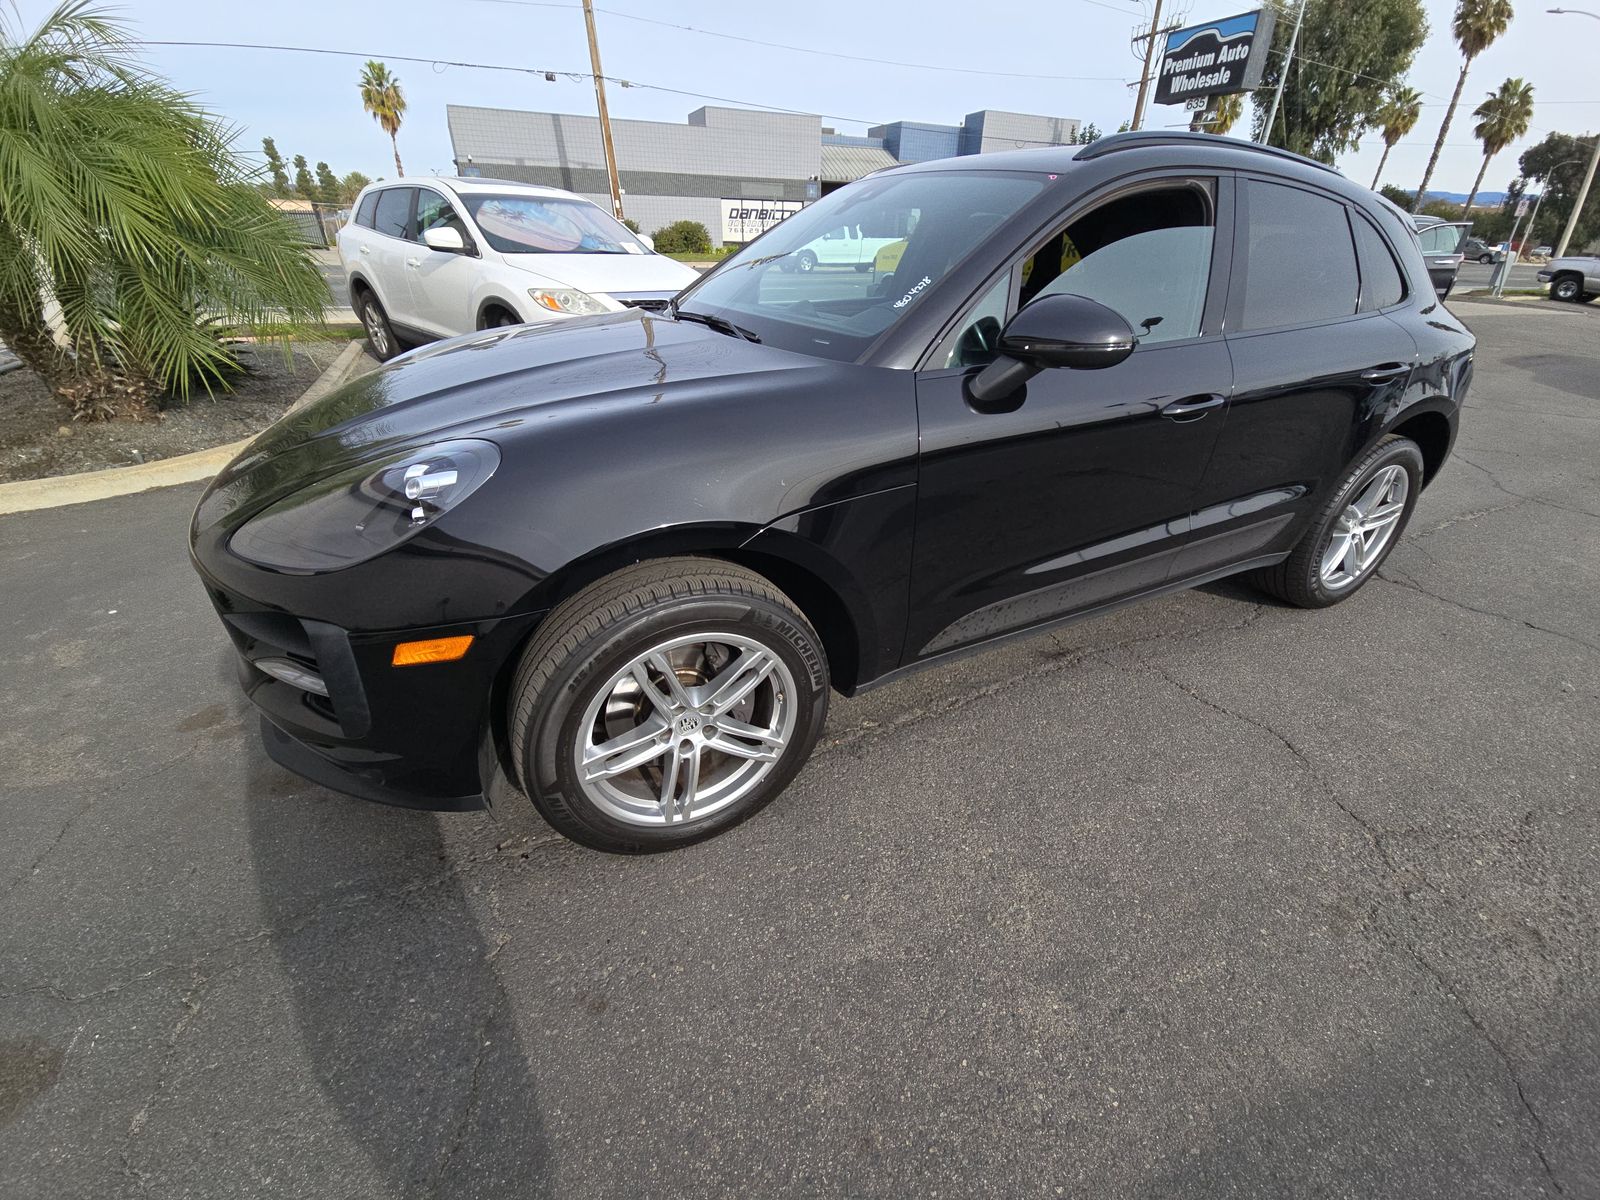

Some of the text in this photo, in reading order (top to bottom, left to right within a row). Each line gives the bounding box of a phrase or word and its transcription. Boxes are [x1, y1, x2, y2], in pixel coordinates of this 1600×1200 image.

[1163, 44, 1249, 75] Premium Auto
[1170, 66, 1231, 94] Wholesale
[1186, 98, 1205, 110] 635
[775, 620, 824, 689] MICHELIN
